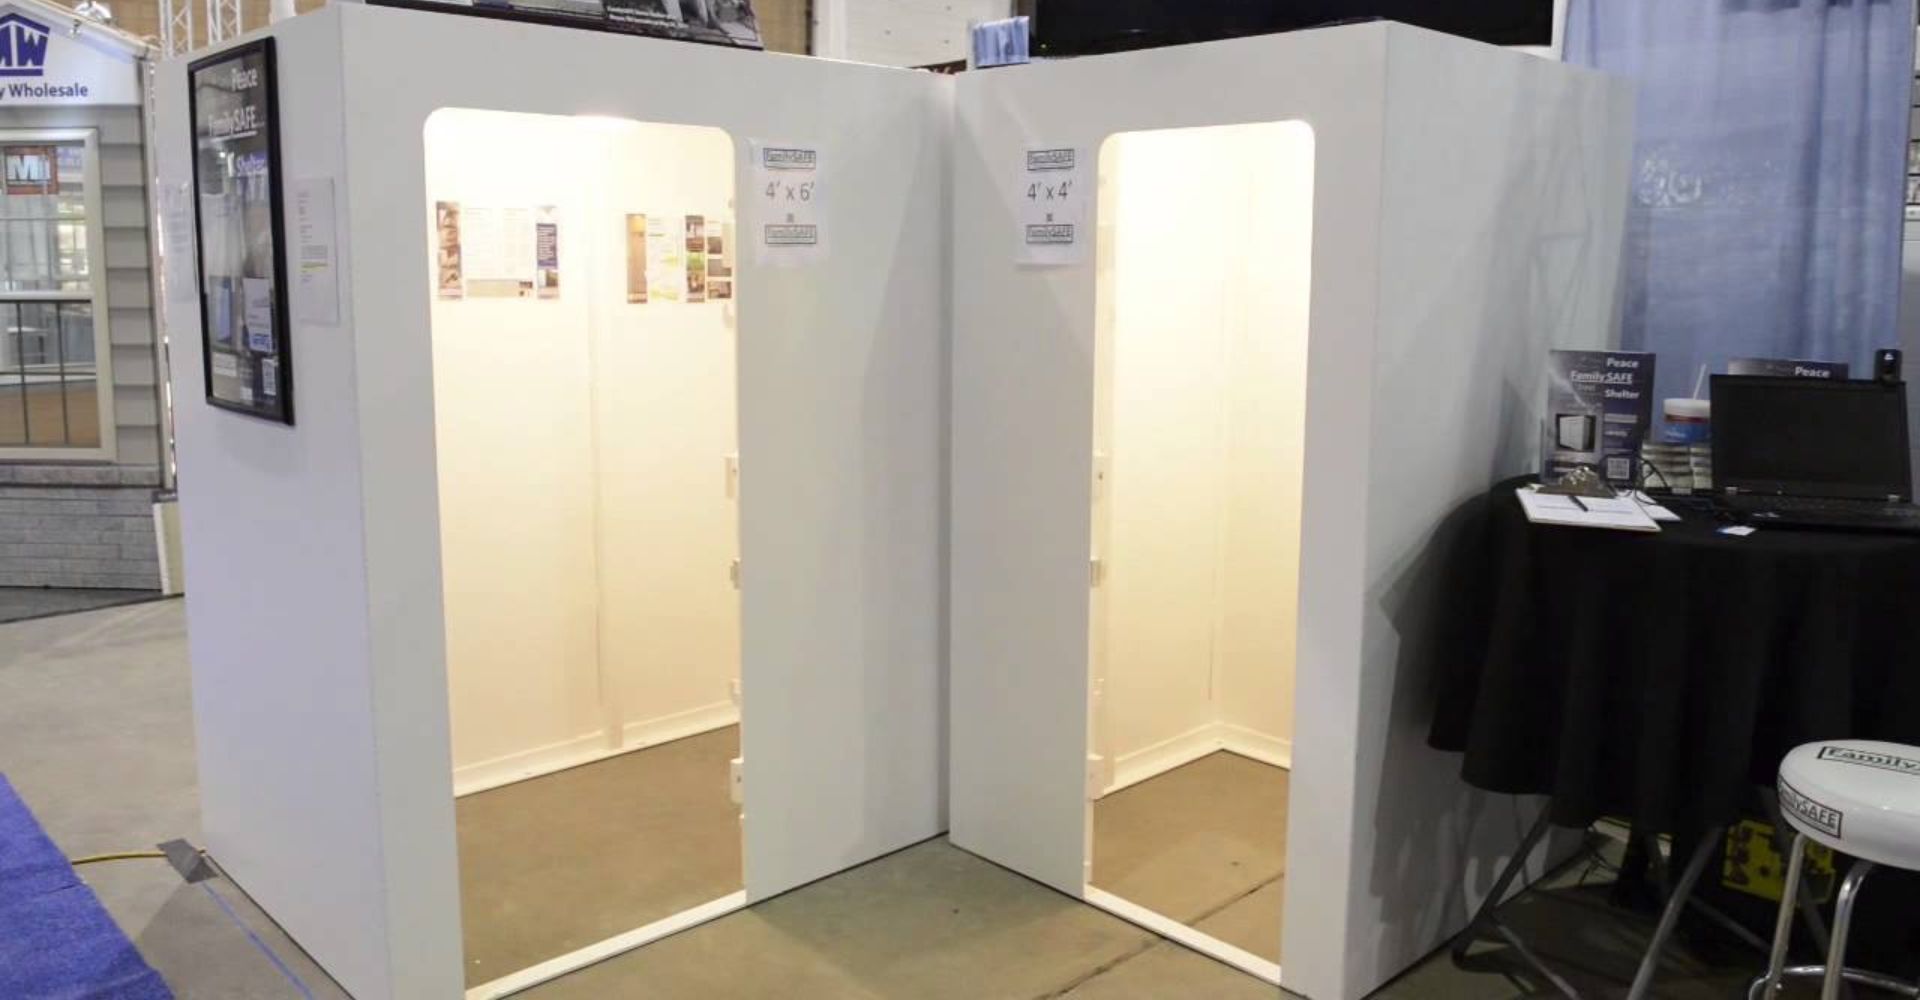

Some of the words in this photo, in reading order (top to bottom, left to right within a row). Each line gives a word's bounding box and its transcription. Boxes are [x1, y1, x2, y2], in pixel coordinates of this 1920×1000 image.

[231, 67, 258, 92] Peace
[8, 82, 88, 98] Wholesale
[766, 181, 781, 198] 4'
[786, 186, 795, 200] x
[800, 181, 815, 202] 6'
[1027, 181, 1042, 200] 4'
[1046, 186, 1054, 200] x
[1058, 180, 1073, 199] 4'
[1606, 357, 1639, 369] Peace
[1570, 370, 1633, 382] FamilySAFE
[1795, 366, 1831, 378] Peace
[1604, 388, 1640, 400] Shelter
